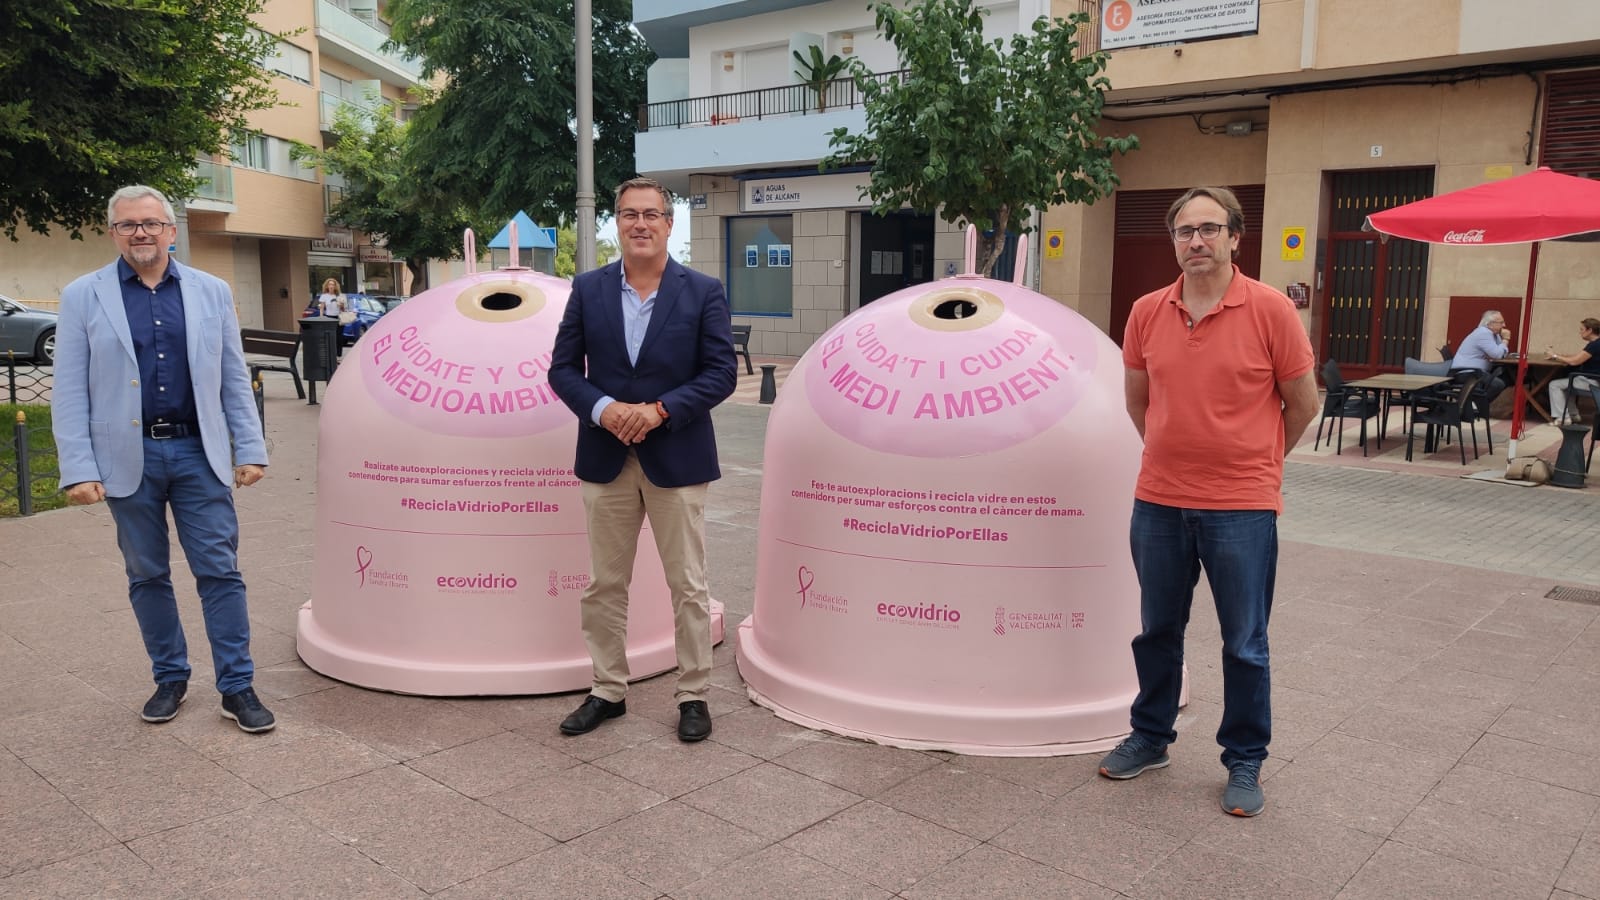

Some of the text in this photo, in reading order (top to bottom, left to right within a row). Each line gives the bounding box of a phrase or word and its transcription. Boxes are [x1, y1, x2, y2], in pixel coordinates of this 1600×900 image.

[1224, 0, 1254, 9] CONTABLE
[1374, 147, 1379, 156] 5
[766, 184, 785, 192] AGUAS
[775, 192, 800, 201] ALICANTE
[399, 326, 475, 385] CUÍDATE
[487, 366, 503, 384] Y
[822, 335, 844, 370] EL
[939, 361, 945, 379] I
[960, 329, 1037, 376] CUIDA
[373, 333, 560, 415] EL MEDIOAMBI
[829, 362, 901, 416] MEDI
[400, 464, 489, 477] autoexploraciones
[491, 468, 497, 477] y
[499, 467, 534, 476] recicla
[536, 467, 566, 476] vidrio
[348, 471, 399, 483] contenedores
[399, 476, 419, 485] para
[421, 478, 450, 486] sumar
[453, 478, 502, 487] esfuerzos
[504, 479, 535, 488] frente
[537, 479, 546, 487] al
[811, 479, 1057, 505] Fes-te autoexploracions i recicla vidre en estos
[401, 497, 559, 513] #ReciclaVidrioPorEllas
[791, 489, 836, 503] contenidors
[837, 496, 852, 505] per
[854, 498, 886, 508] sumar
[888, 500, 937, 513] esforços
[939, 505, 977, 514] contra
[980, 505, 990, 515] el
[1035, 507, 1049, 516] de
[1051, 508, 1085, 517] mama.
[843, 518, 1008, 542] #ReciclaVidrioPorEllas
[370, 569, 409, 582] Fundación
[437, 573, 517, 589] ecovidrio
[810, 590, 848, 606] Fundación
[877, 602, 960, 622] ecovidrio
[1008, 612, 1063, 621] GENERALITAT
[1009, 621, 1062, 629] VALENCIANA
